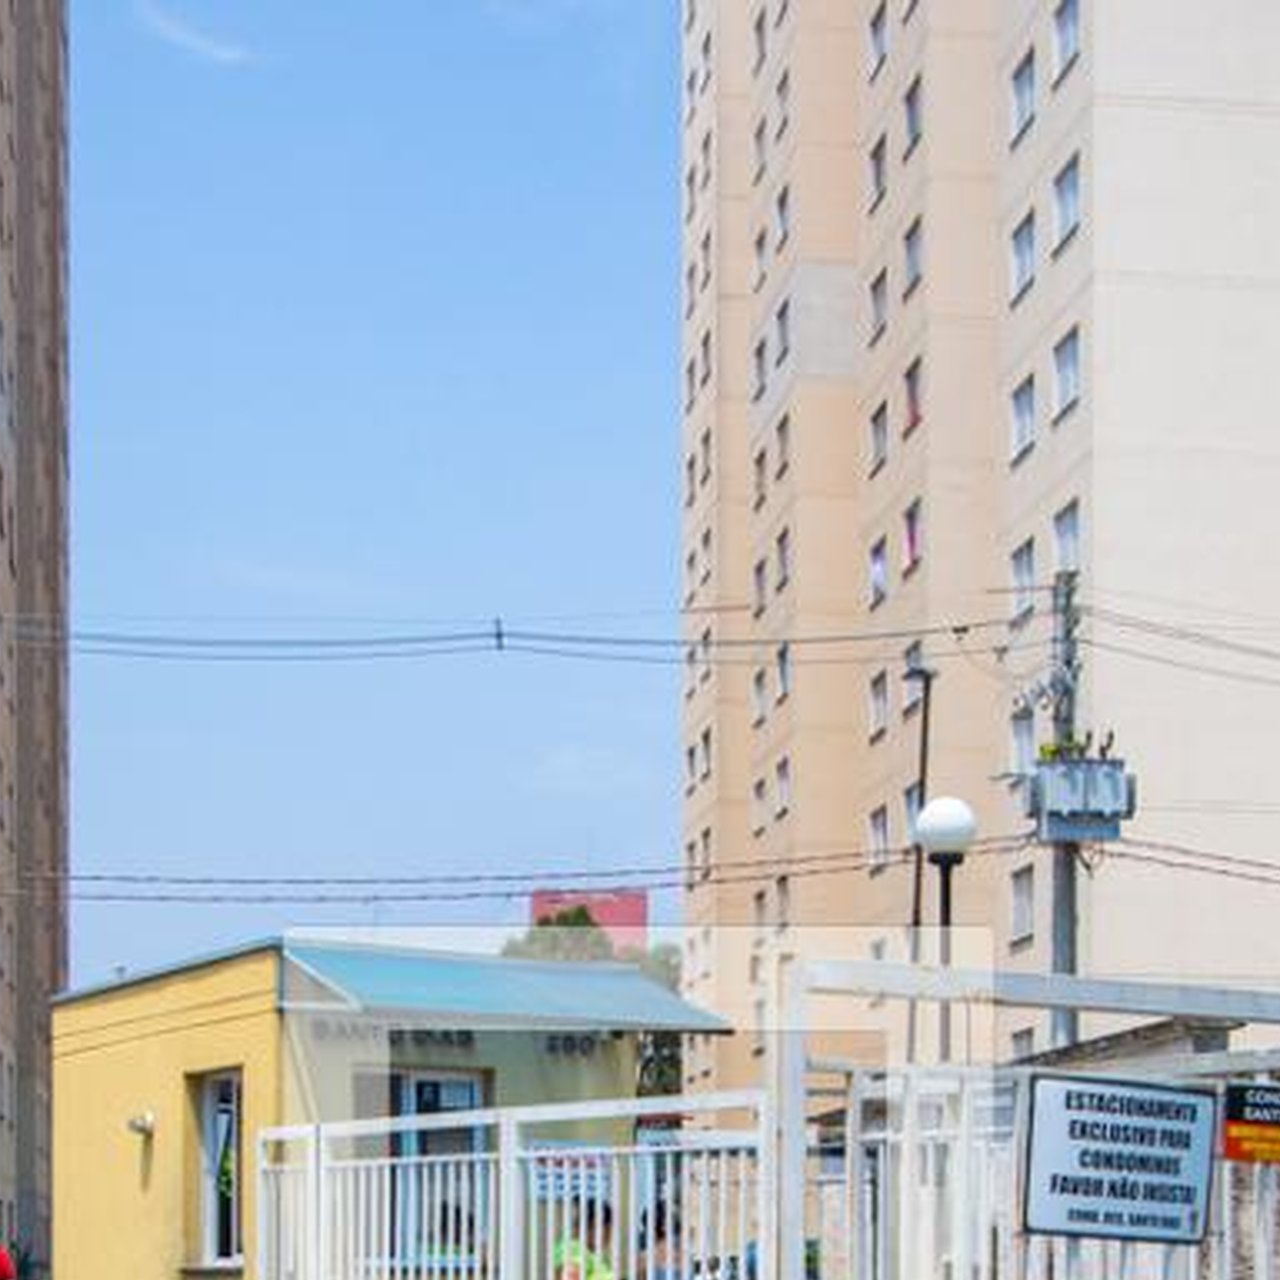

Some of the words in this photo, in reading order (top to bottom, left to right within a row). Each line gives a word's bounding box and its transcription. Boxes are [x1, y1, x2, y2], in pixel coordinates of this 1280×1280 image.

[1066, 1089, 1198, 1123] ESTACIONAMENTO
[1069, 1119, 1157, 1147] EXCLUSIVO
[1160, 1129, 1191, 1149] PARA
[1050, 1173, 1104, 1198] FAVOR
[1107, 1176, 1140, 1200] NÃO
